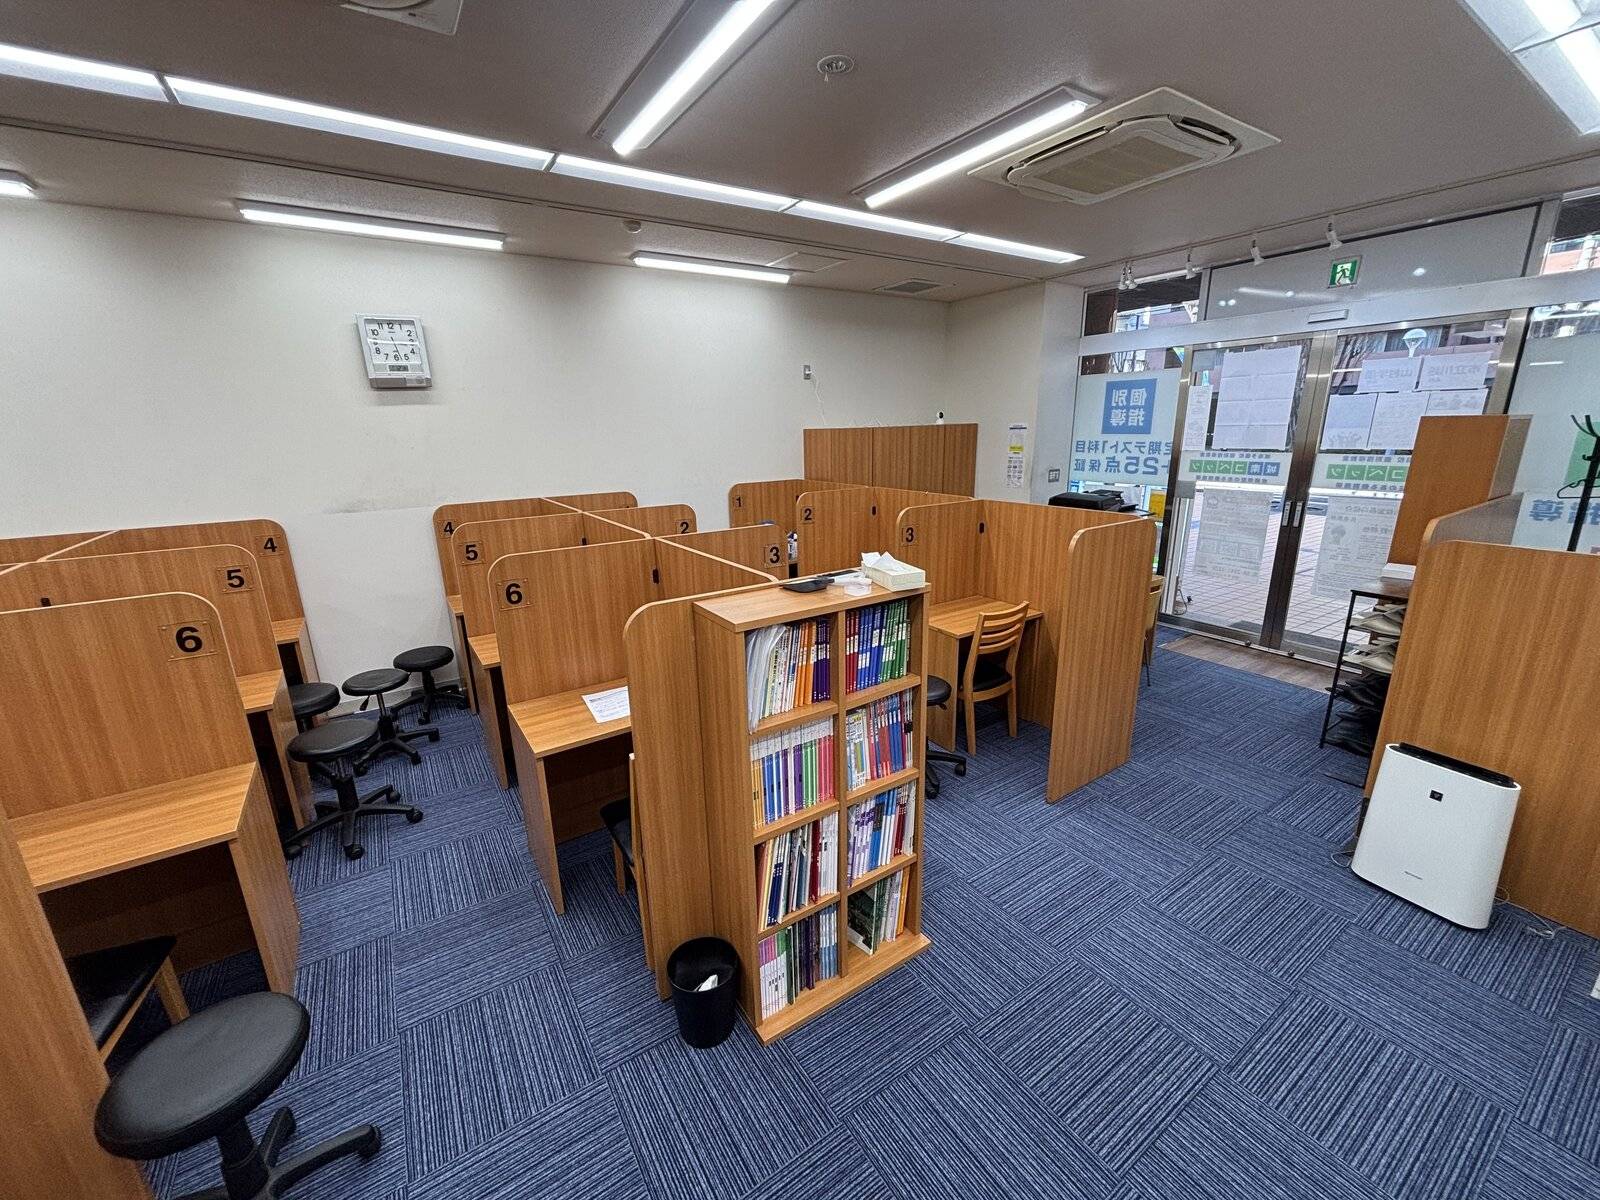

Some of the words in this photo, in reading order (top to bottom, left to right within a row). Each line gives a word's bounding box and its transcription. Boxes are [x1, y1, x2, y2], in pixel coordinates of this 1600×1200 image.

[735, 497, 741, 507] 1
[804, 508, 812, 521] 2
[444, 521, 454, 535] 4
[680, 522, 689, 534] 2
[905, 527, 914, 543] 3
[263, 537, 277, 552] 4
[465, 545, 479, 561] 5
[769, 546, 780, 564] 3
[226, 569, 245, 588] 5
[505, 583, 522, 605] 6
[175, 626, 203, 653] 6
